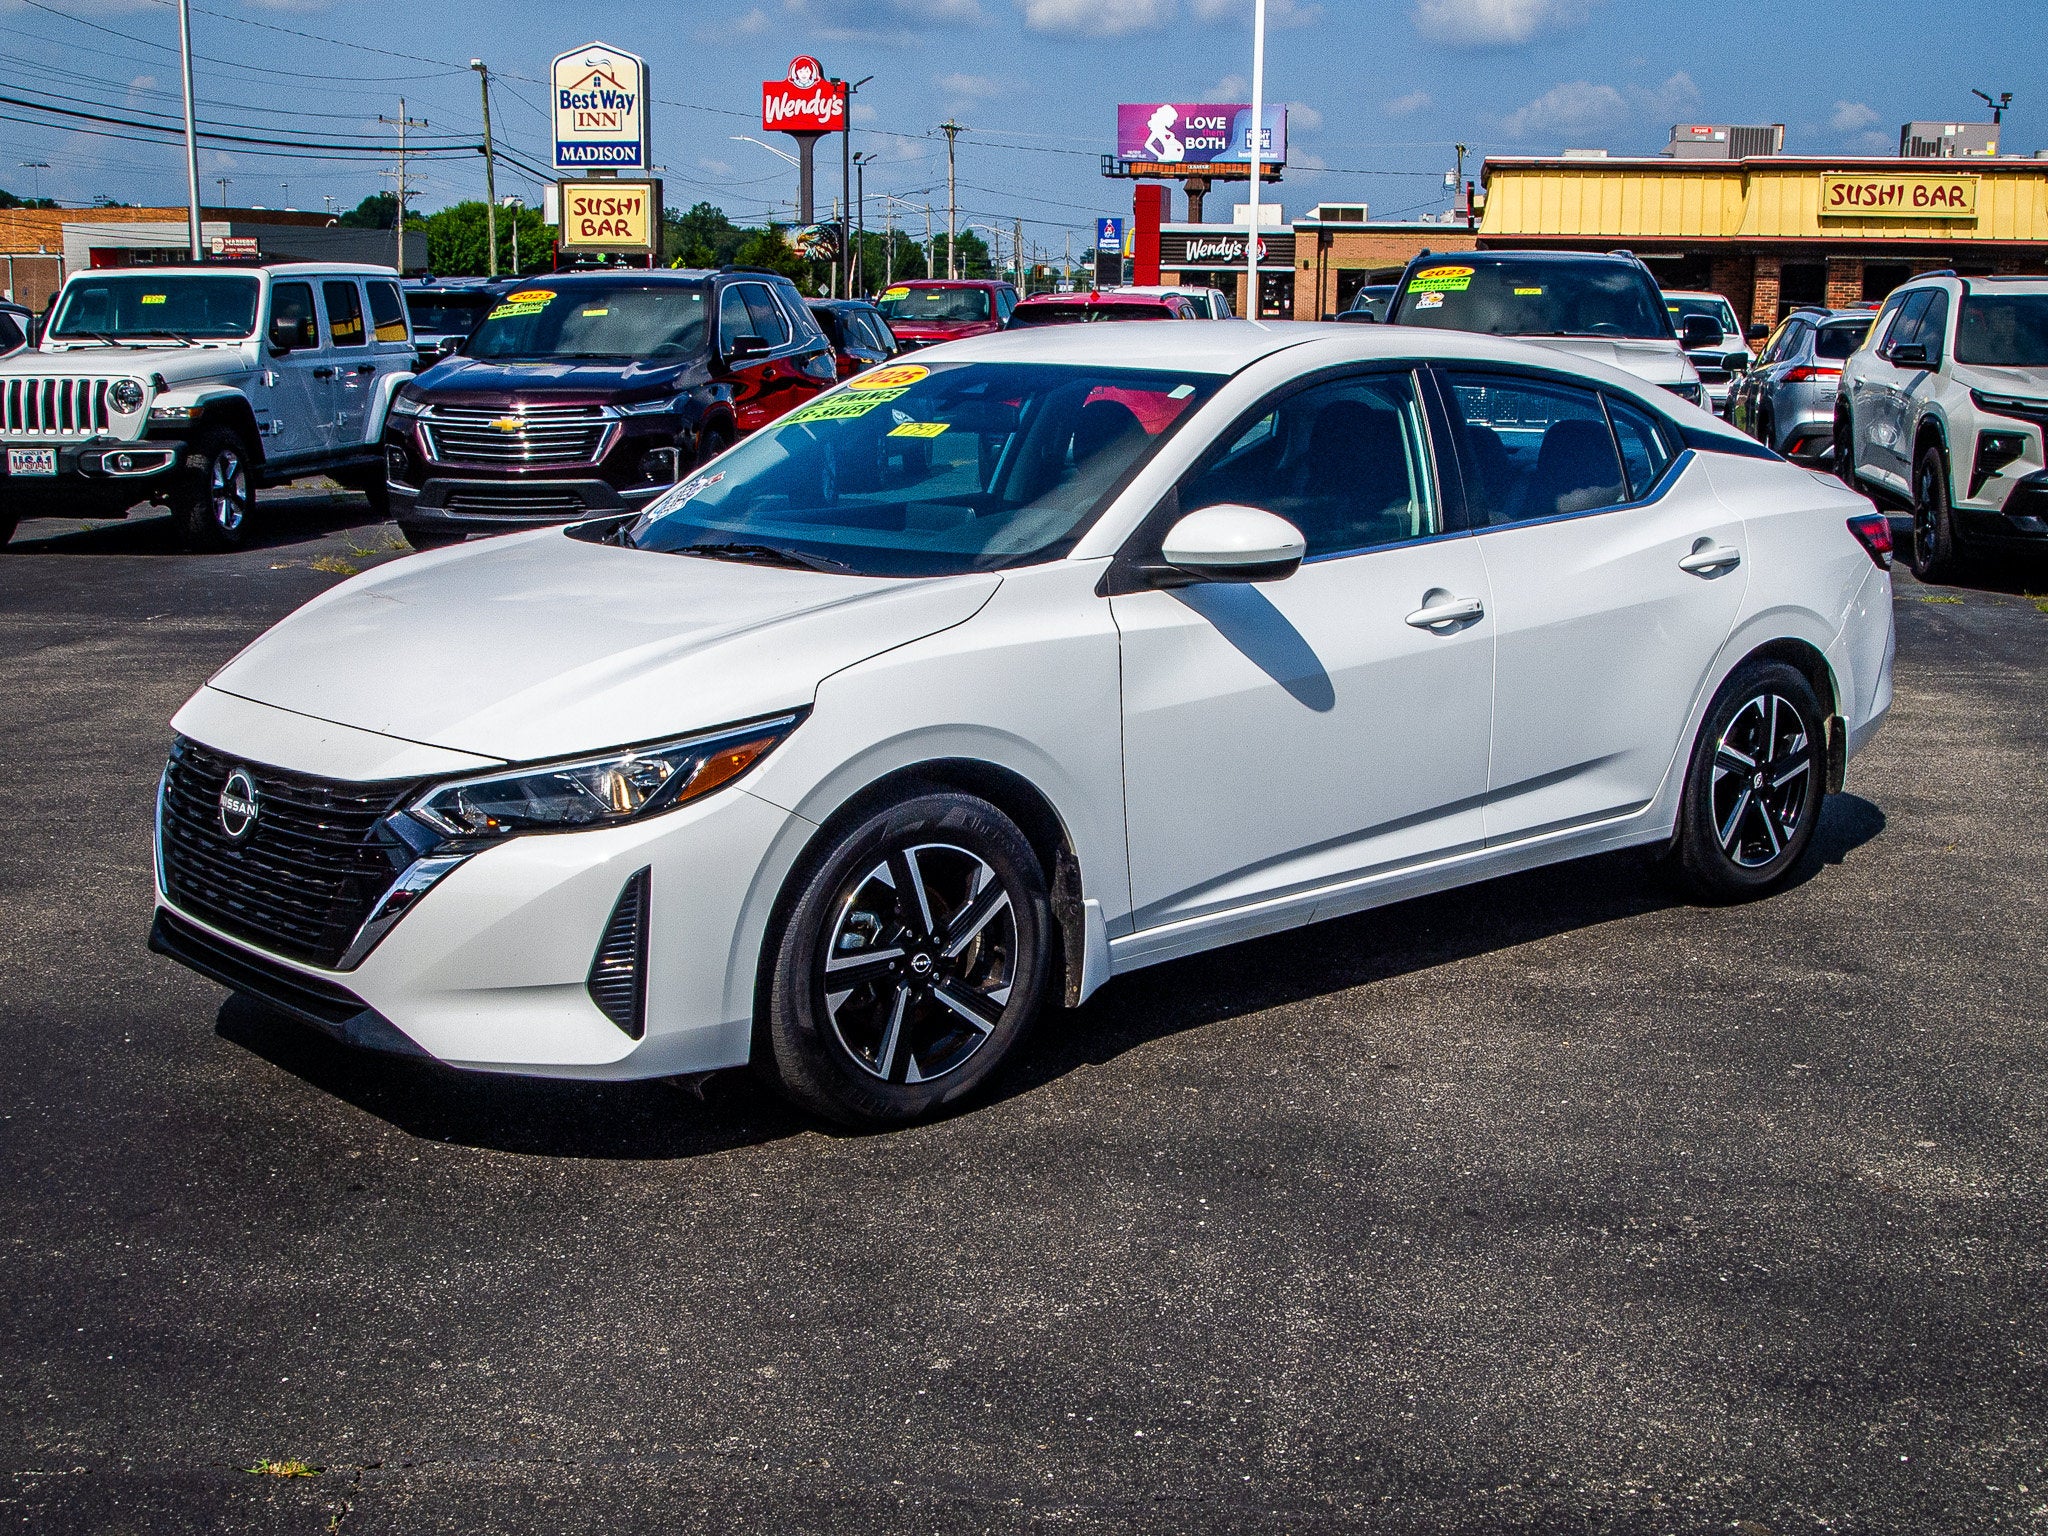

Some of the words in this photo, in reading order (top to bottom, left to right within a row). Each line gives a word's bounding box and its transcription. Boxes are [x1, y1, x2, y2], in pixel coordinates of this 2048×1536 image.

[560, 89, 597, 109] Best
[599, 89, 635, 115] Way
[765, 88, 843, 123] Wendy's
[578, 112, 617, 127] INN
[1185, 116, 1226, 129] LOVE
[1202, 129, 1225, 137] them
[1185, 137, 1226, 149] BOTH
[561, 147, 636, 161] MADISON
[1830, 183, 1904, 206] SUSHI
[1912, 184, 1967, 207] BAR
[573, 197, 641, 217] SUSHI
[581, 218, 632, 237] BAR
[1186, 236, 1242, 262] Wendy's
[1423, 268, 1468, 278] 2025
[1411, 277, 1469, 287] NAVIGATION
[512, 292, 553, 300] 2023
[853, 370, 925, 384] 2025
[220, 794, 256, 816] NISSAN
